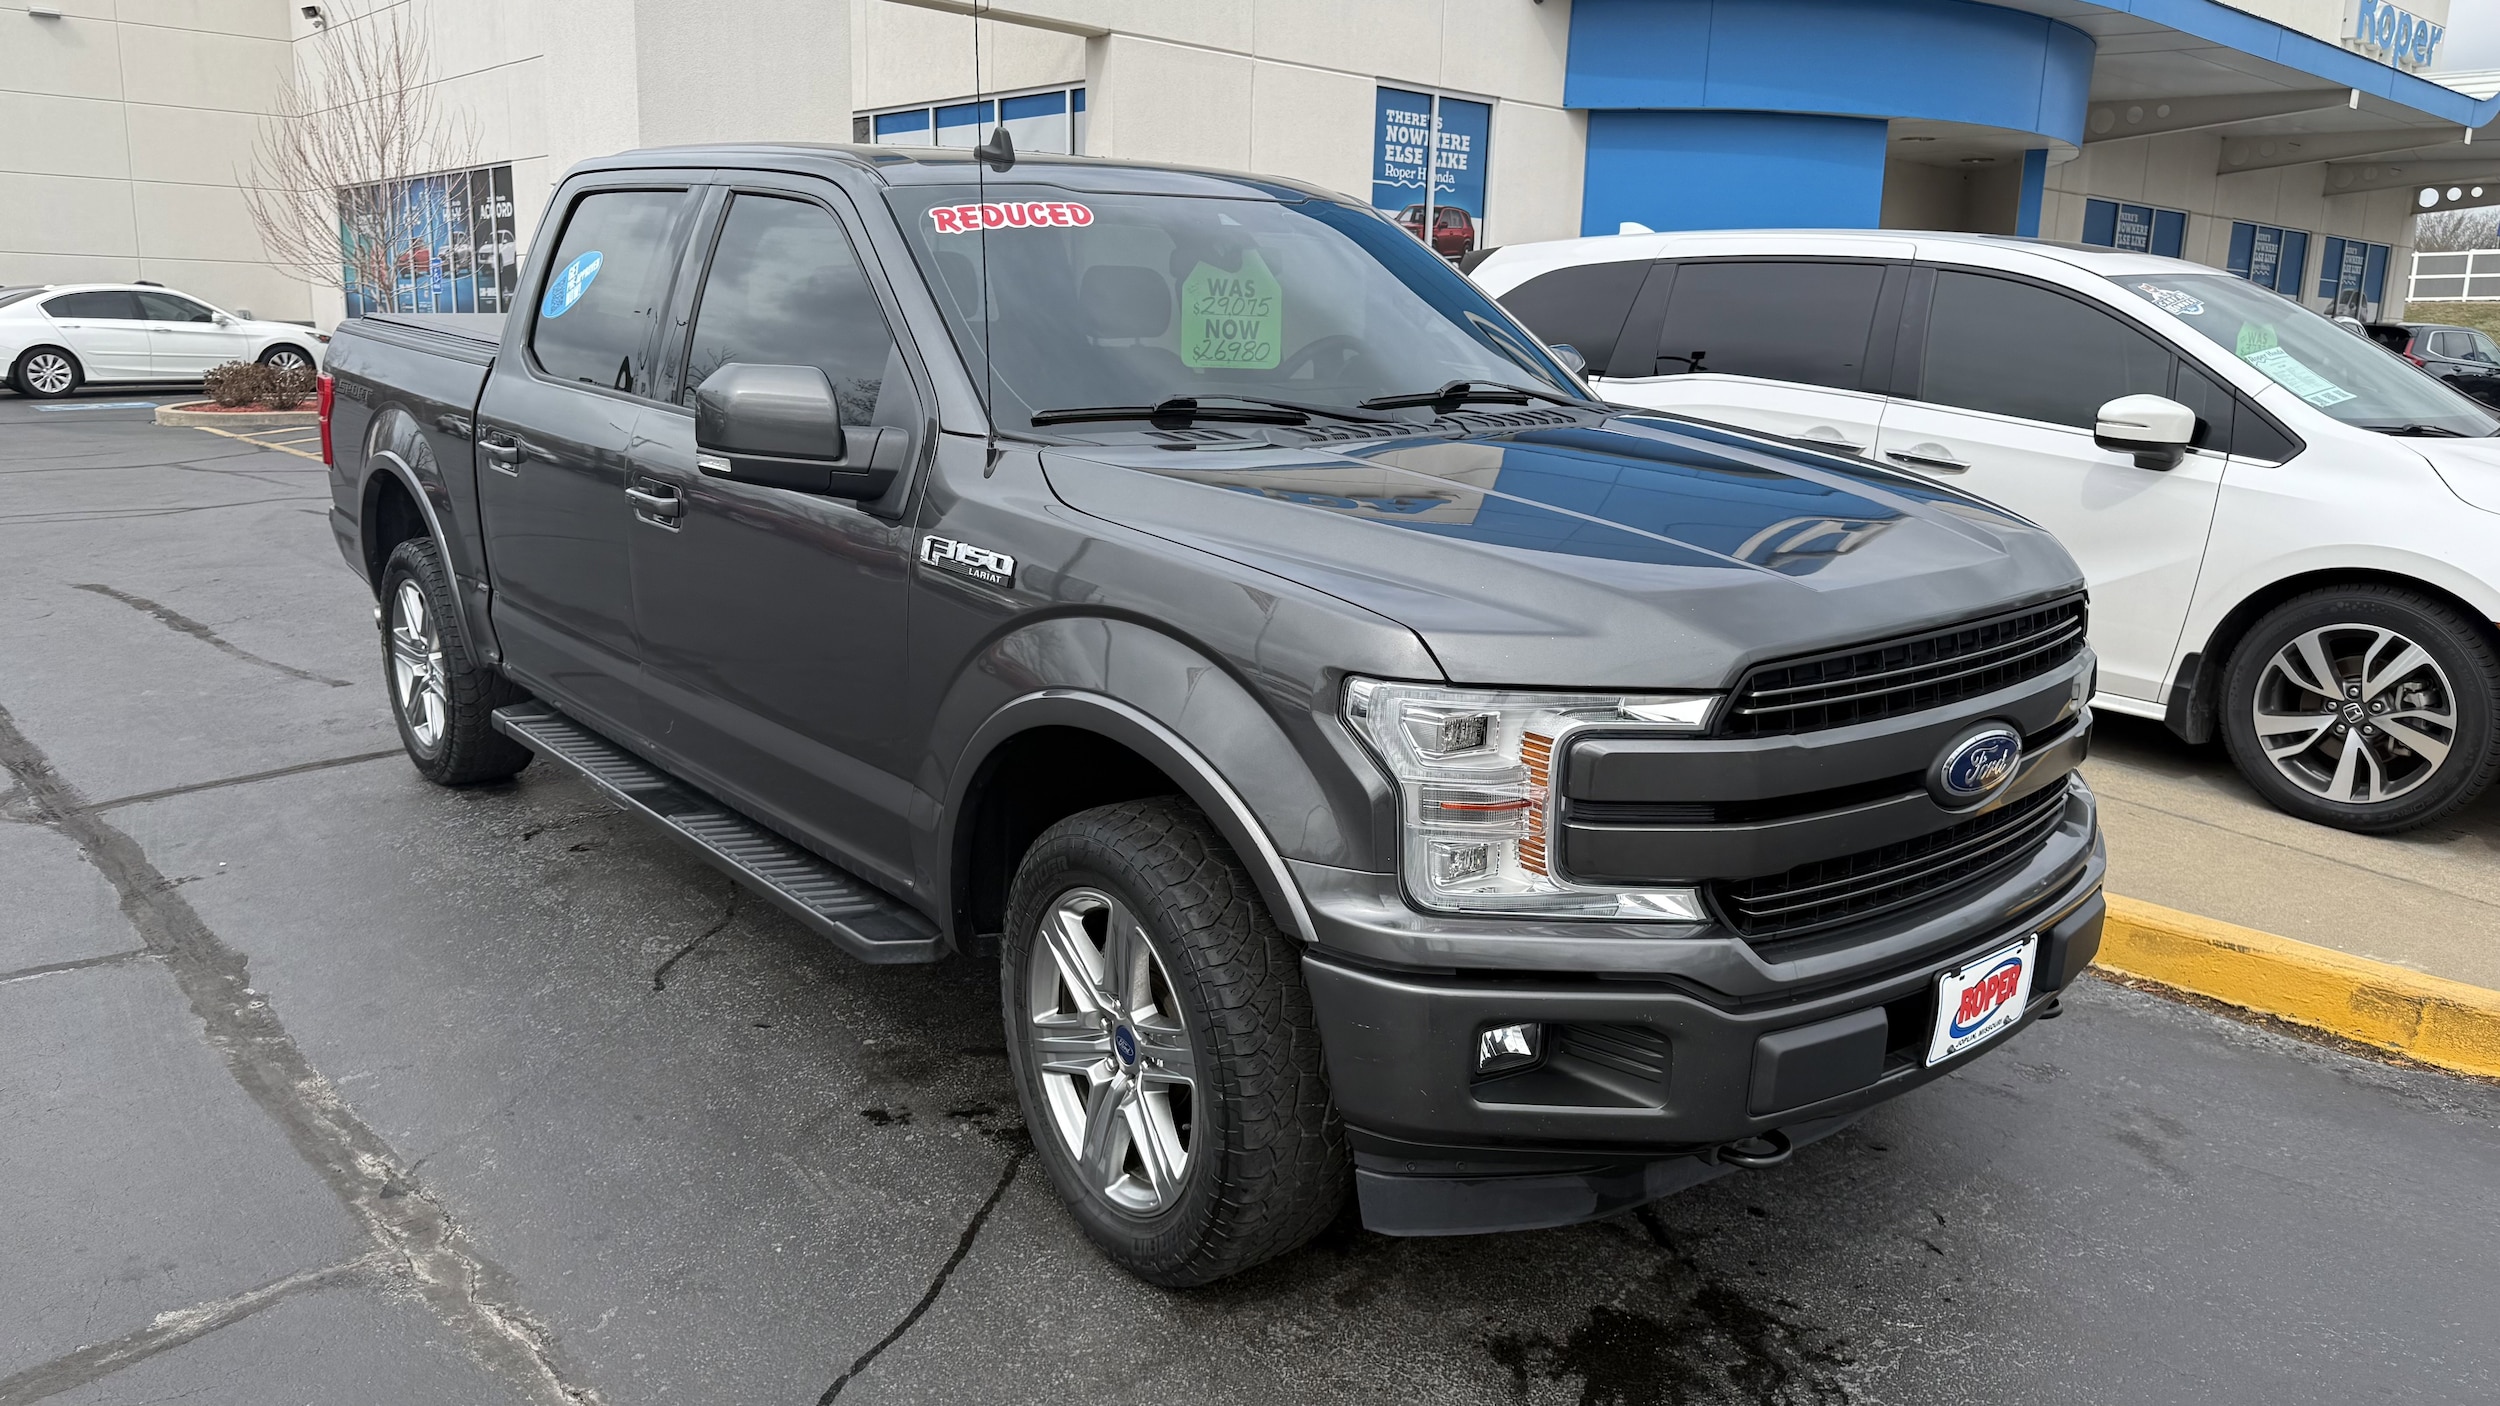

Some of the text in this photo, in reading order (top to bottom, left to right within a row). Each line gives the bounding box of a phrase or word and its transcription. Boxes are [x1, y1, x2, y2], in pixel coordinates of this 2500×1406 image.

[2357, 0, 2443, 67] Roper
[1385, 109, 1443, 129] THERE'S
[1385, 125, 1471, 152] NOWHERE
[1385, 144, 1468, 170] ELSE LIKE
[1384, 163, 1455, 184] Roper Hnda
[480, 201, 513, 220] ACORD
[932, 203, 1092, 233] REDUCED
[1207, 278, 1255, 298] WAS
[1193, 296, 1272, 318] $29,075
[1205, 318, 1260, 340] NOW
[1193, 339, 1271, 364] $26,980
[968, 567, 1002, 584] LARIAT
[1965, 745, 2009, 785] Ford
[1957, 964, 2020, 1025] ROPER
